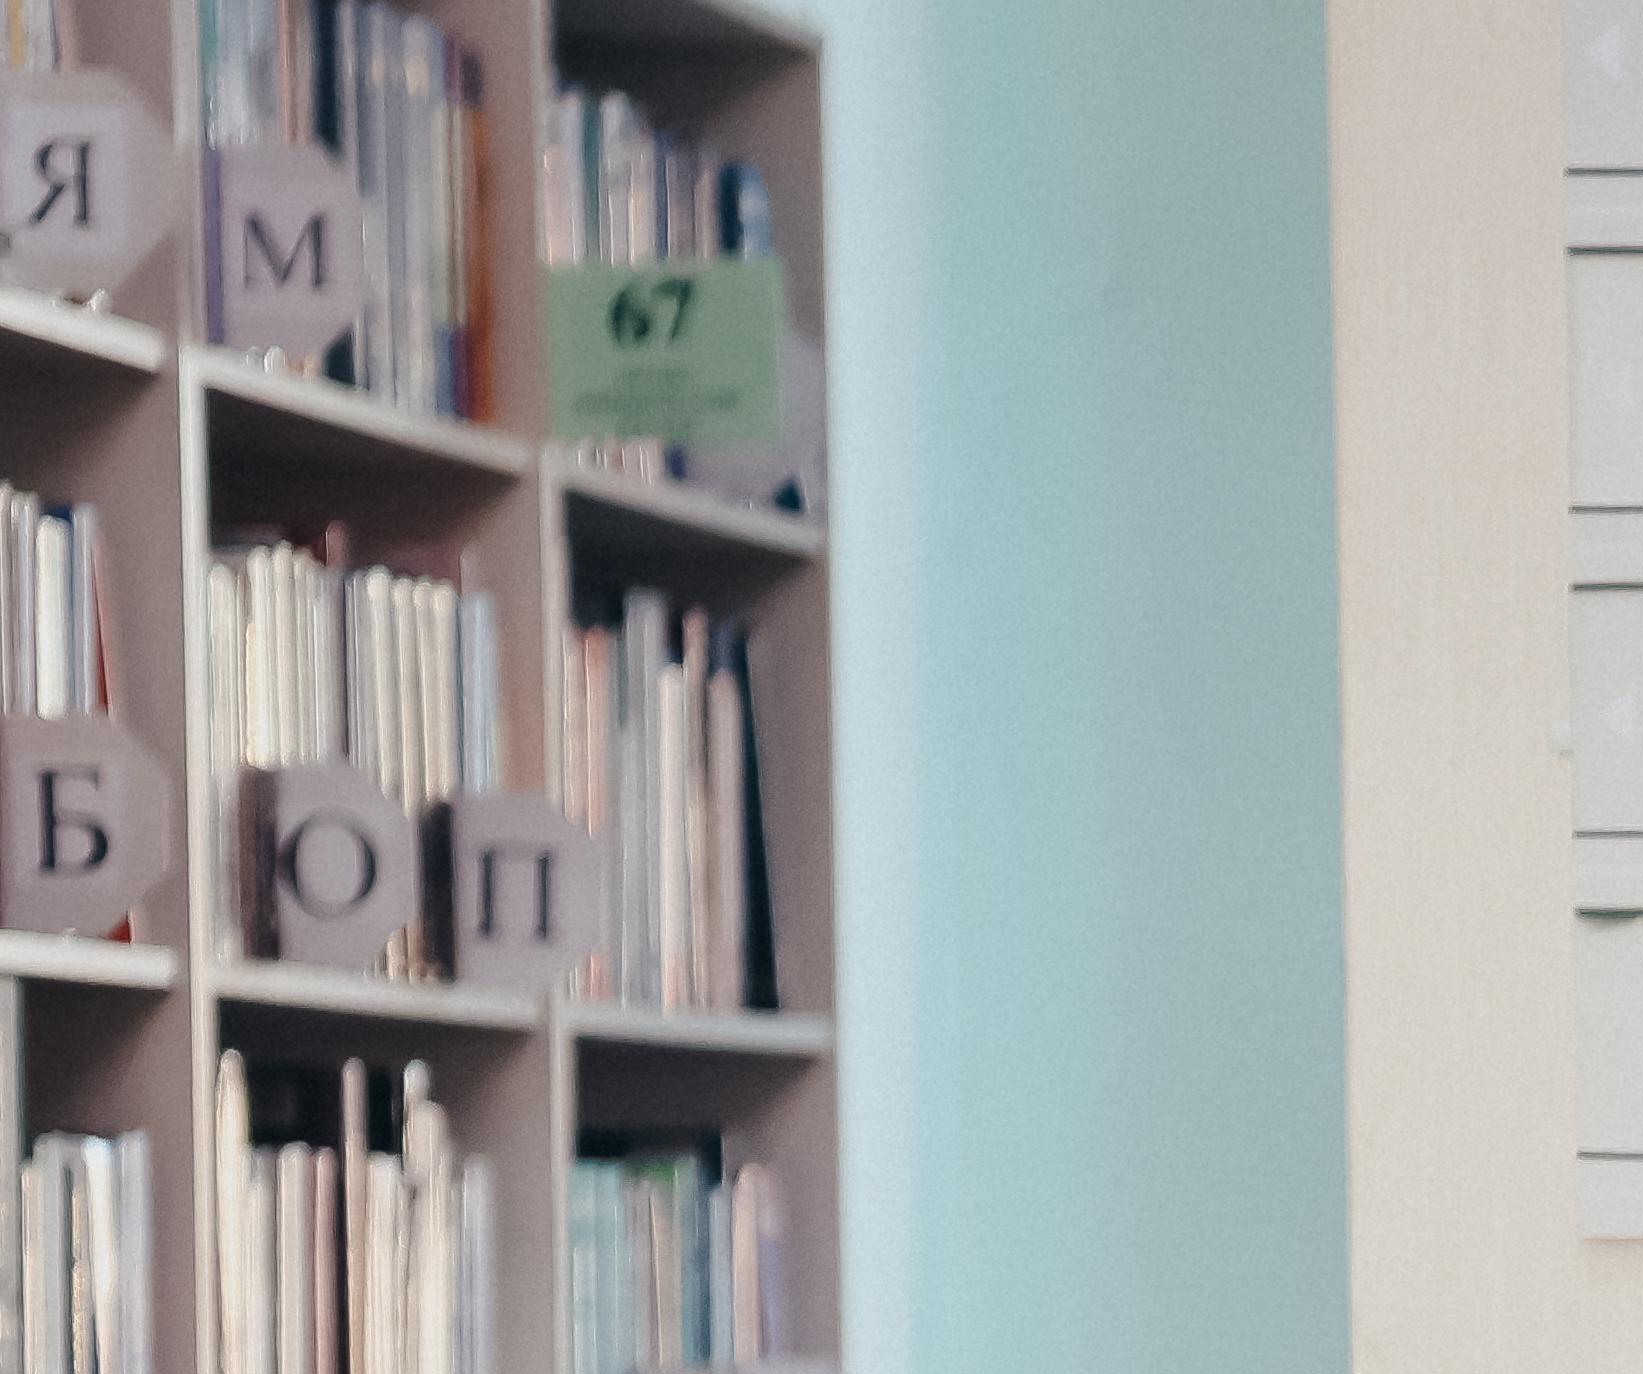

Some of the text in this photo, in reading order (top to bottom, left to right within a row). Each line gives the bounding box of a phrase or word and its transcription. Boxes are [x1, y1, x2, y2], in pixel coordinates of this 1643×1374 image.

[29, 136, 95, 227] Я
[242, 208, 327, 292] М
[607, 277, 695, 347] 67
[37, 767, 109, 876] Б
[276, 804, 377, 922] О
[476, 838, 558, 940] П
